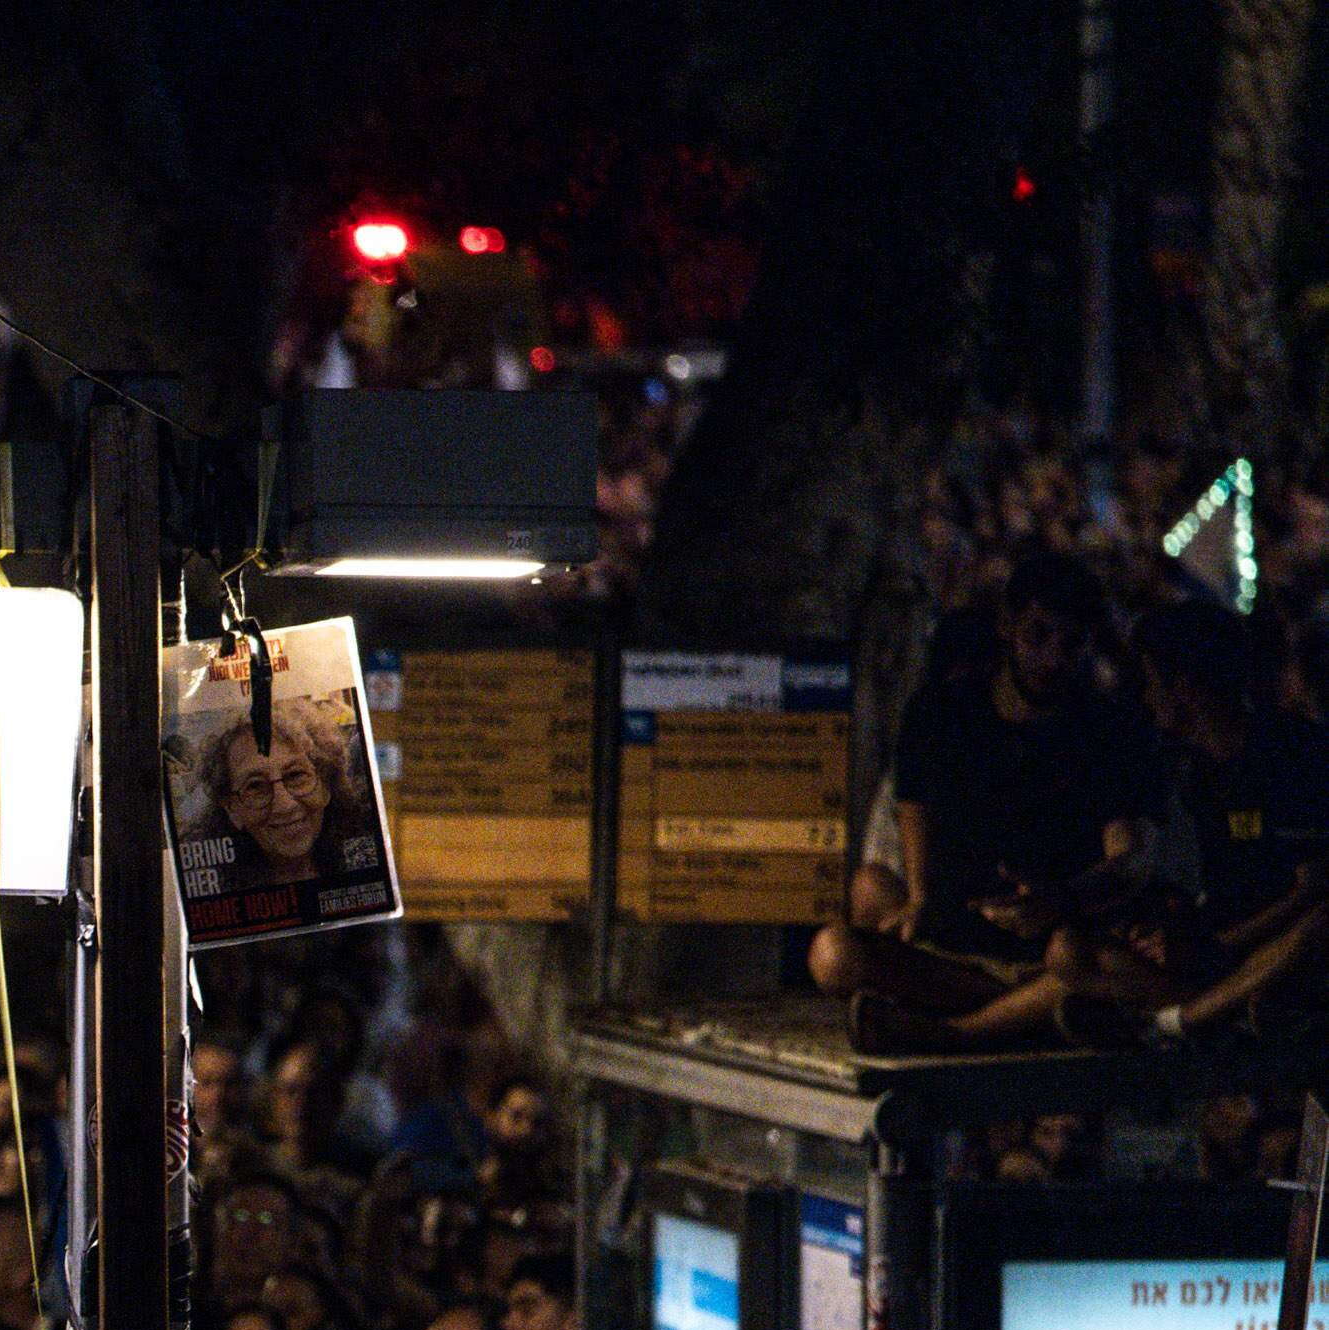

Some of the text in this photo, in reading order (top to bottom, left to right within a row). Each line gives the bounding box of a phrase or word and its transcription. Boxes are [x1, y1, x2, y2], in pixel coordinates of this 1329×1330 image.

[179, 836, 236, 871] BRING
[184, 868, 222, 899] HER
[188, 895, 241, 931] HOME
[244, 883, 300, 922] NOW!
[1131, 1280, 1168, 1307] את
[1180, 1275, 1231, 1306] לכם
